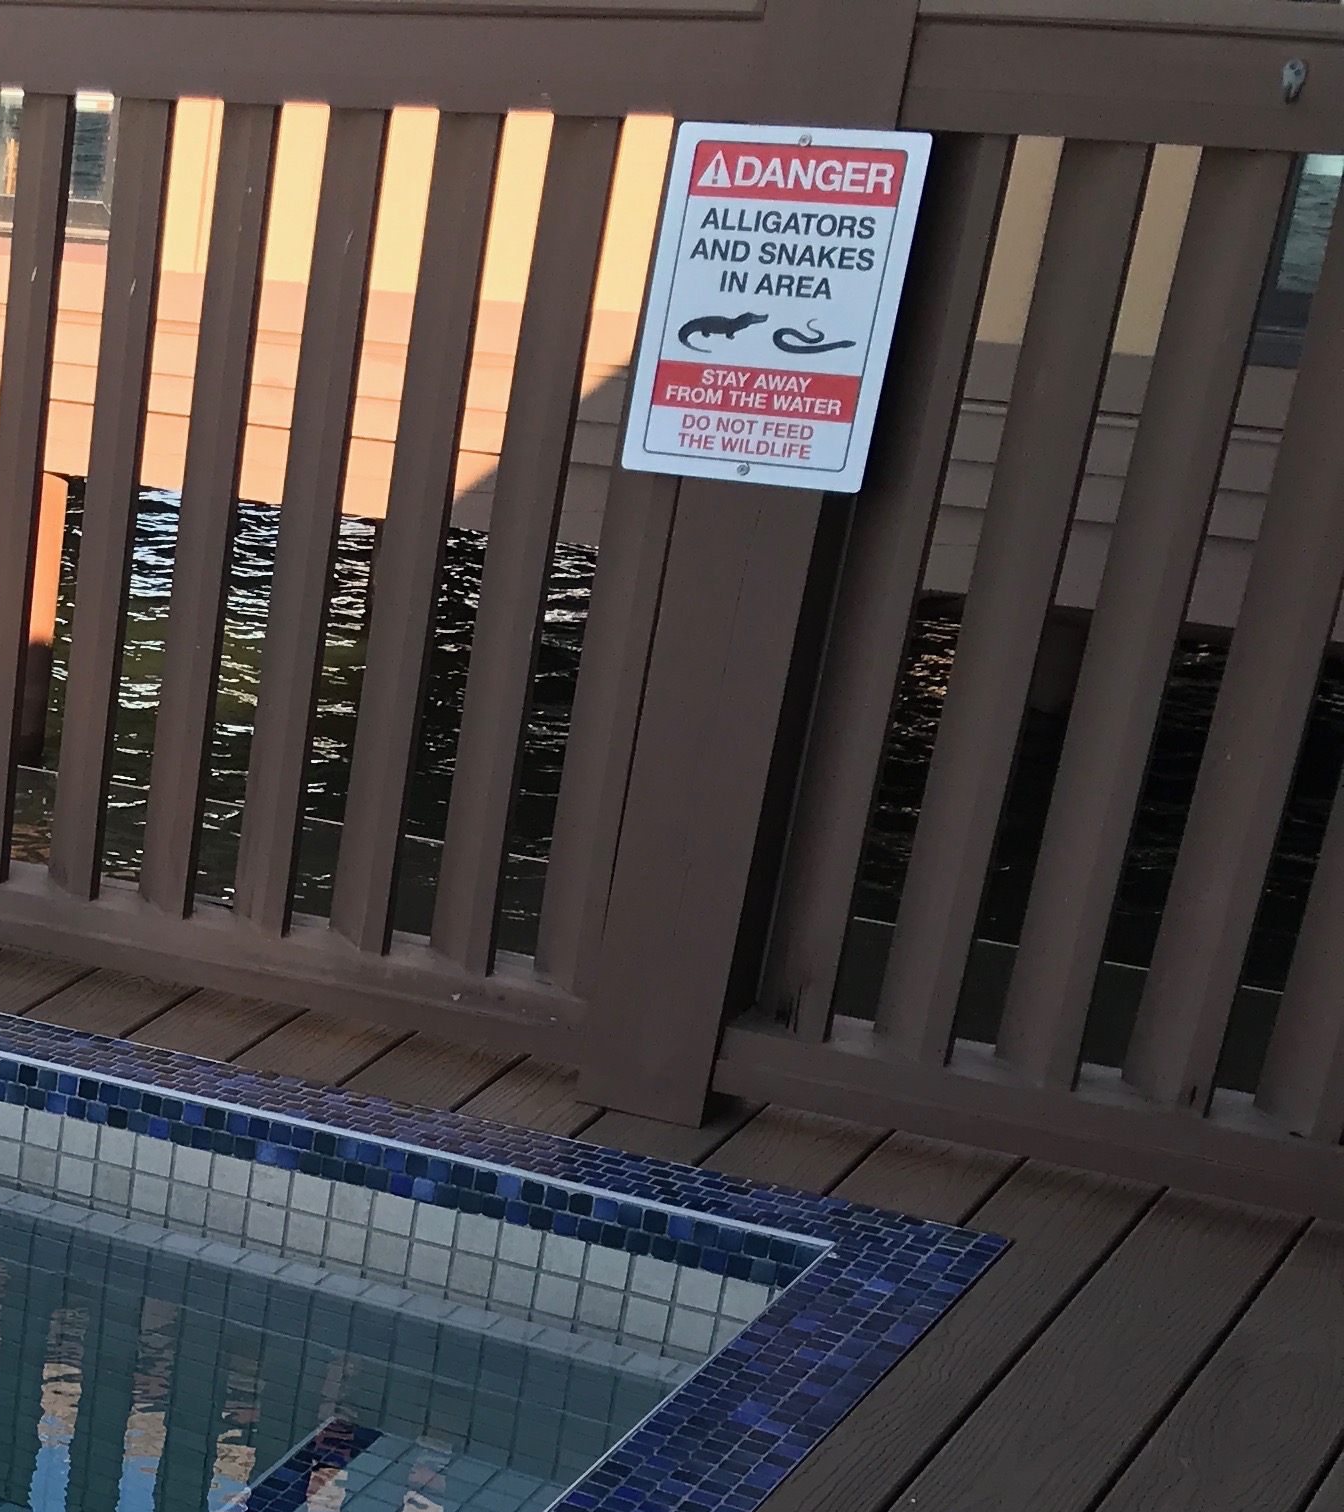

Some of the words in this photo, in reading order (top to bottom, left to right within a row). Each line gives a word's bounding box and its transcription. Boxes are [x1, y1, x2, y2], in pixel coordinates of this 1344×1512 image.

[734, 156, 894, 194] DANGER
[700, 208, 875, 239] ALLIGATORS
[690, 238, 750, 262] AND
[758, 242, 875, 271] SNAKES
[719, 271, 747, 293] IN
[755, 274, 832, 299] AREA
[701, 369, 750, 387] STAY
[753, 374, 811, 393] AWAY
[665, 385, 723, 404] FROM
[728, 391, 768, 410] THE
[773, 395, 842, 416] WATER
[682, 414, 711, 431] DO
[716, 416, 758, 435] NOT
[762, 422, 814, 441] FEED
[678, 433, 715, 450] THE
[720, 437, 812, 460] WILDLIFE
